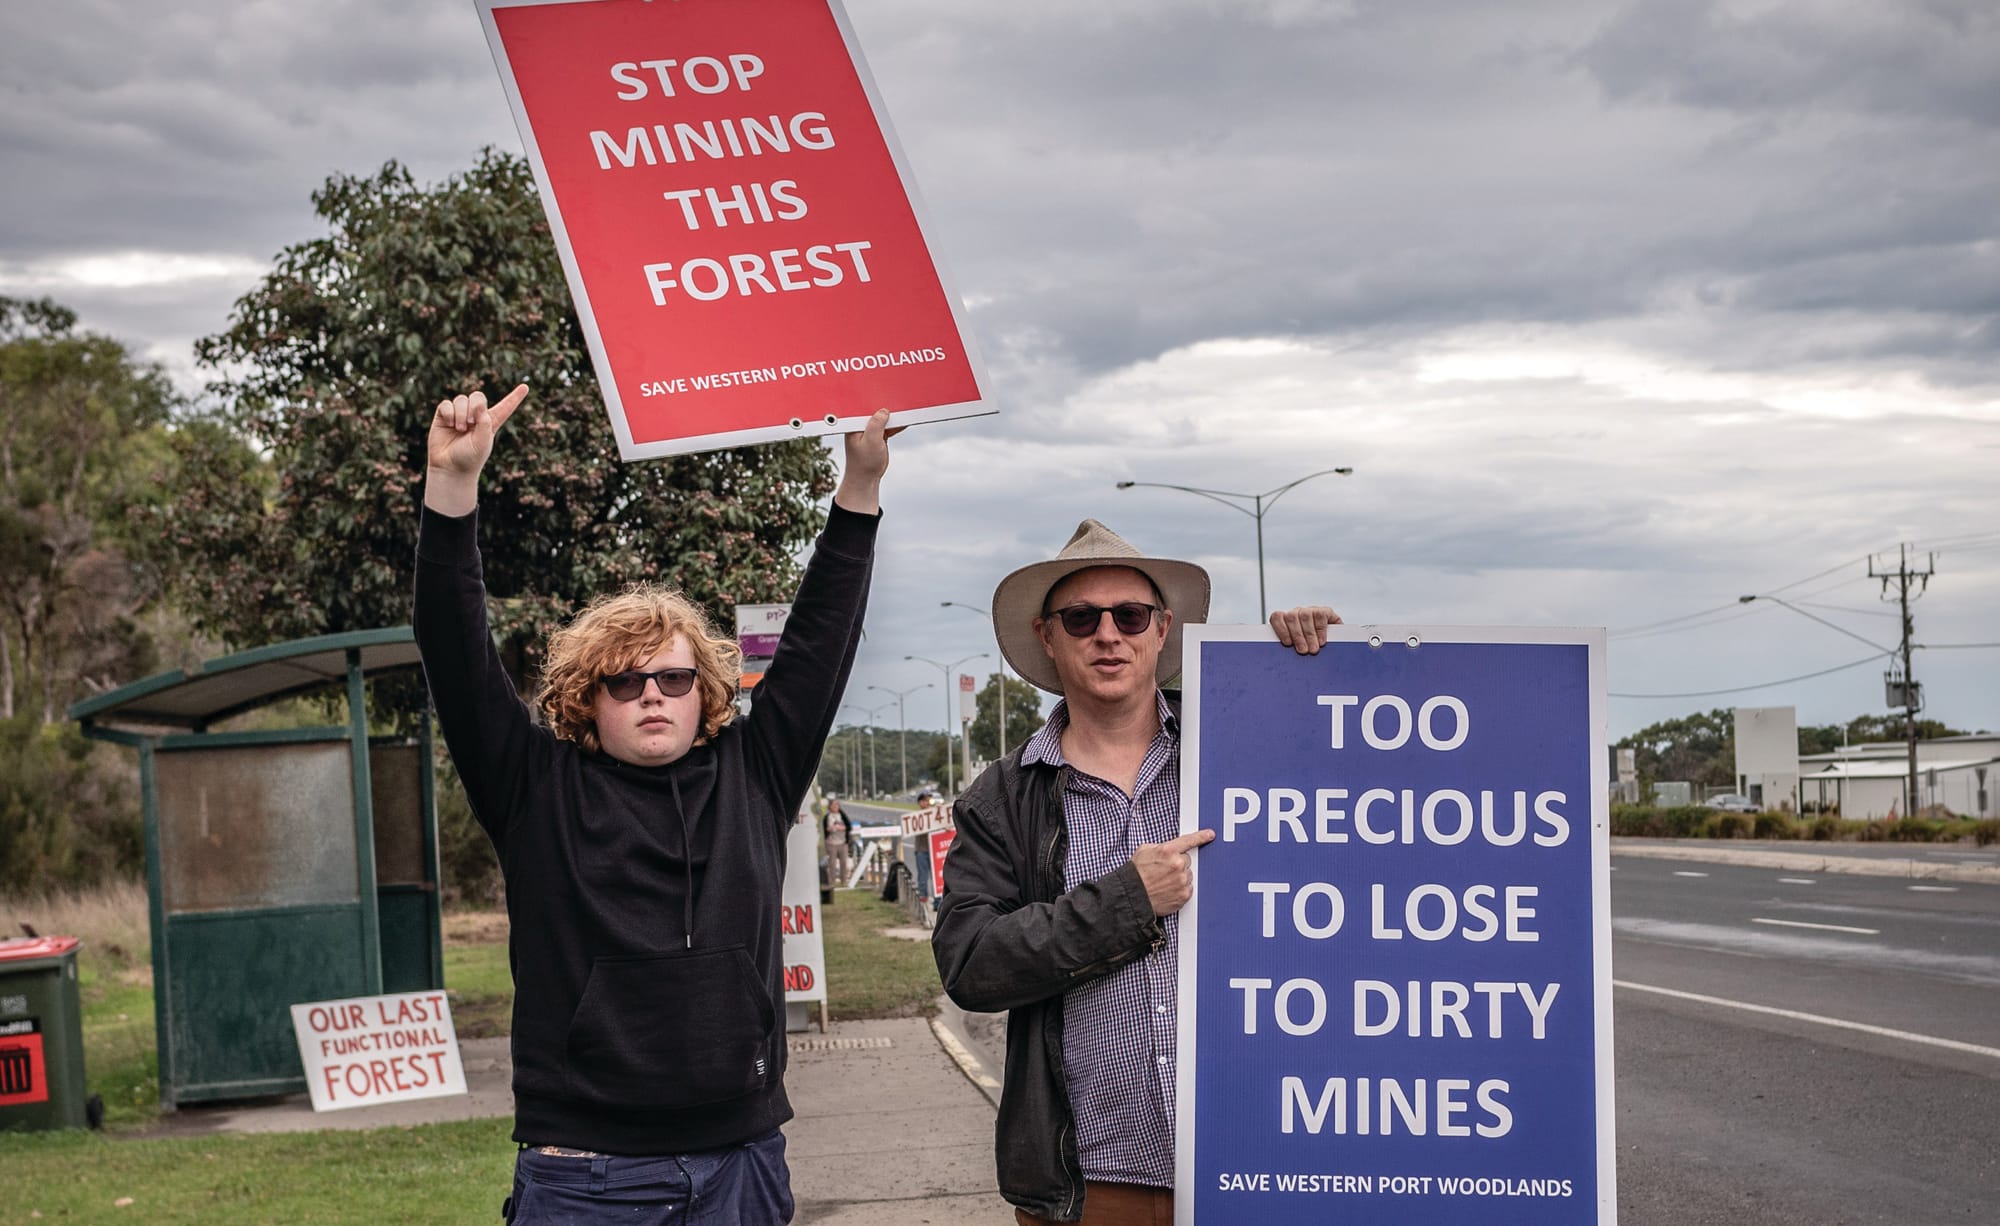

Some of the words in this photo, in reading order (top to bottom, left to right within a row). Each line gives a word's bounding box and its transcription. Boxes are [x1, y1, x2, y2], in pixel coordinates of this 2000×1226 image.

[610, 53, 765, 101] STOP
[589, 111, 836, 170] MINING
[663, 179, 808, 231] THIS
[643, 240, 872, 307] FOREST
[639, 380, 689, 398] SAVE
[689, 367, 778, 391] WESTERN
[780, 360, 827, 380] PORT
[830, 347, 946, 373] WOODLANDS
[1316, 694, 1470, 751] TOO
[902, 811, 933, 835] TOOT
[935, 805, 944, 824] 4
[1222, 787, 1570, 848] PRECIOUS
[1247, 881, 1345, 940] TO
[1371, 883, 1540, 942] LOSE
[309, 1004, 367, 1033] OUR
[377, 995, 443, 1027] LAST
[1229, 977, 1327, 1036] TO
[1353, 979, 1561, 1040] DIRTY
[321, 1028, 447, 1057] FUNCTIONAL
[323, 1051, 446, 1101] FOREST
[1281, 1076, 1513, 1138] MINES
[1218, 1173, 1270, 1192] SAVE
[1275, 1174, 1372, 1194] WESTERN
[1378, 1176, 1433, 1195] PORT
[1437, 1177, 1573, 1197] WOODLANDS
